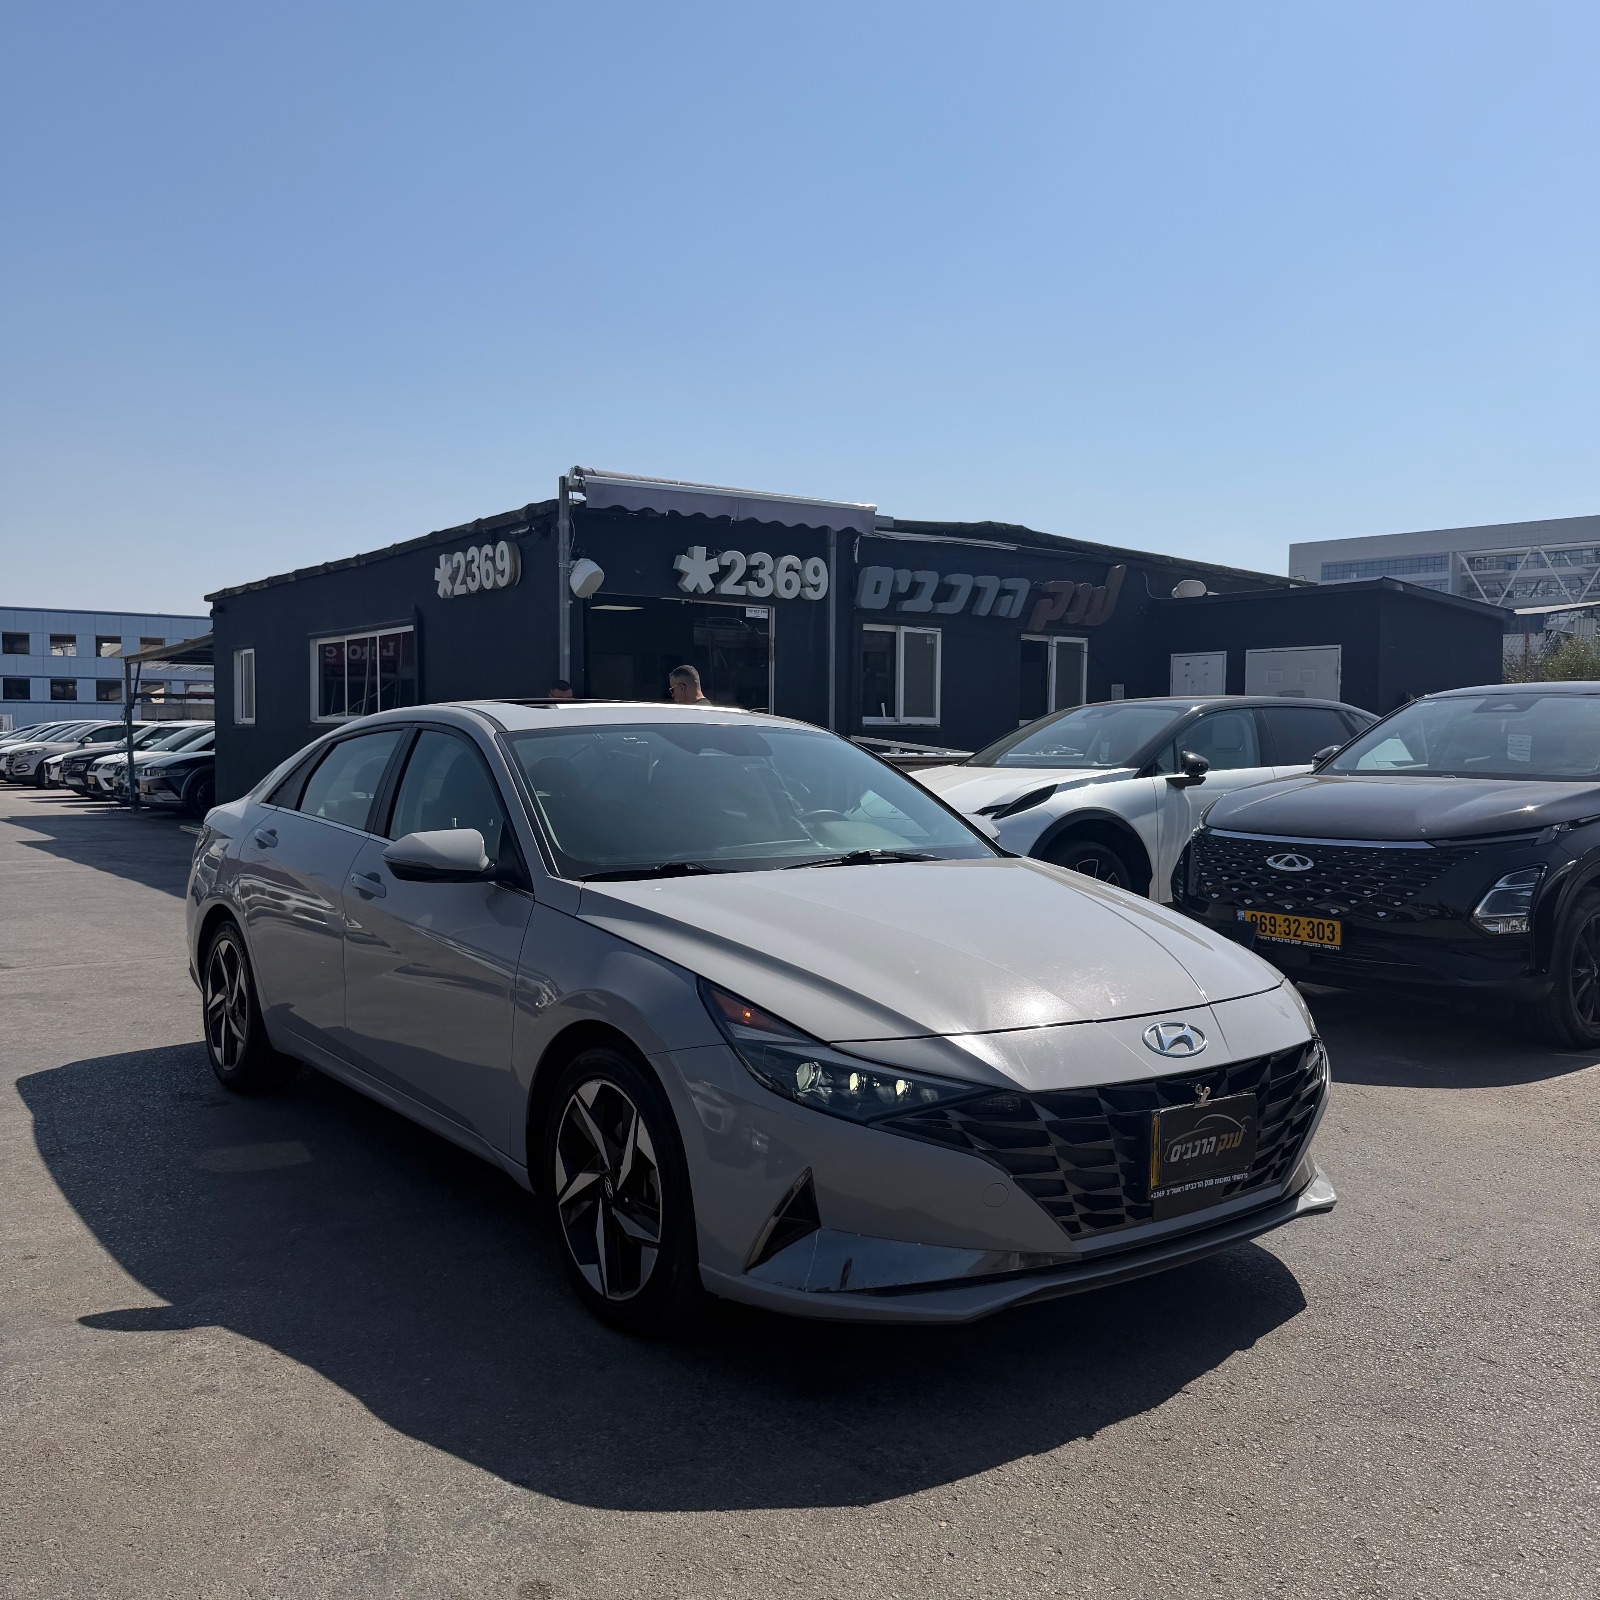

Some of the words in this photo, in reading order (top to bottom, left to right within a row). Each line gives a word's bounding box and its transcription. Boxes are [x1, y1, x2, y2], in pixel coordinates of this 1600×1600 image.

[857, 566, 1030, 618] הרכבים
[1027, 564, 1126, 632] ענק
[1170, 1136, 1216, 1163] הרכבים
[1216, 1124, 1245, 1156] ענק
[1185, 1181, 1203, 1191] הרכבים
